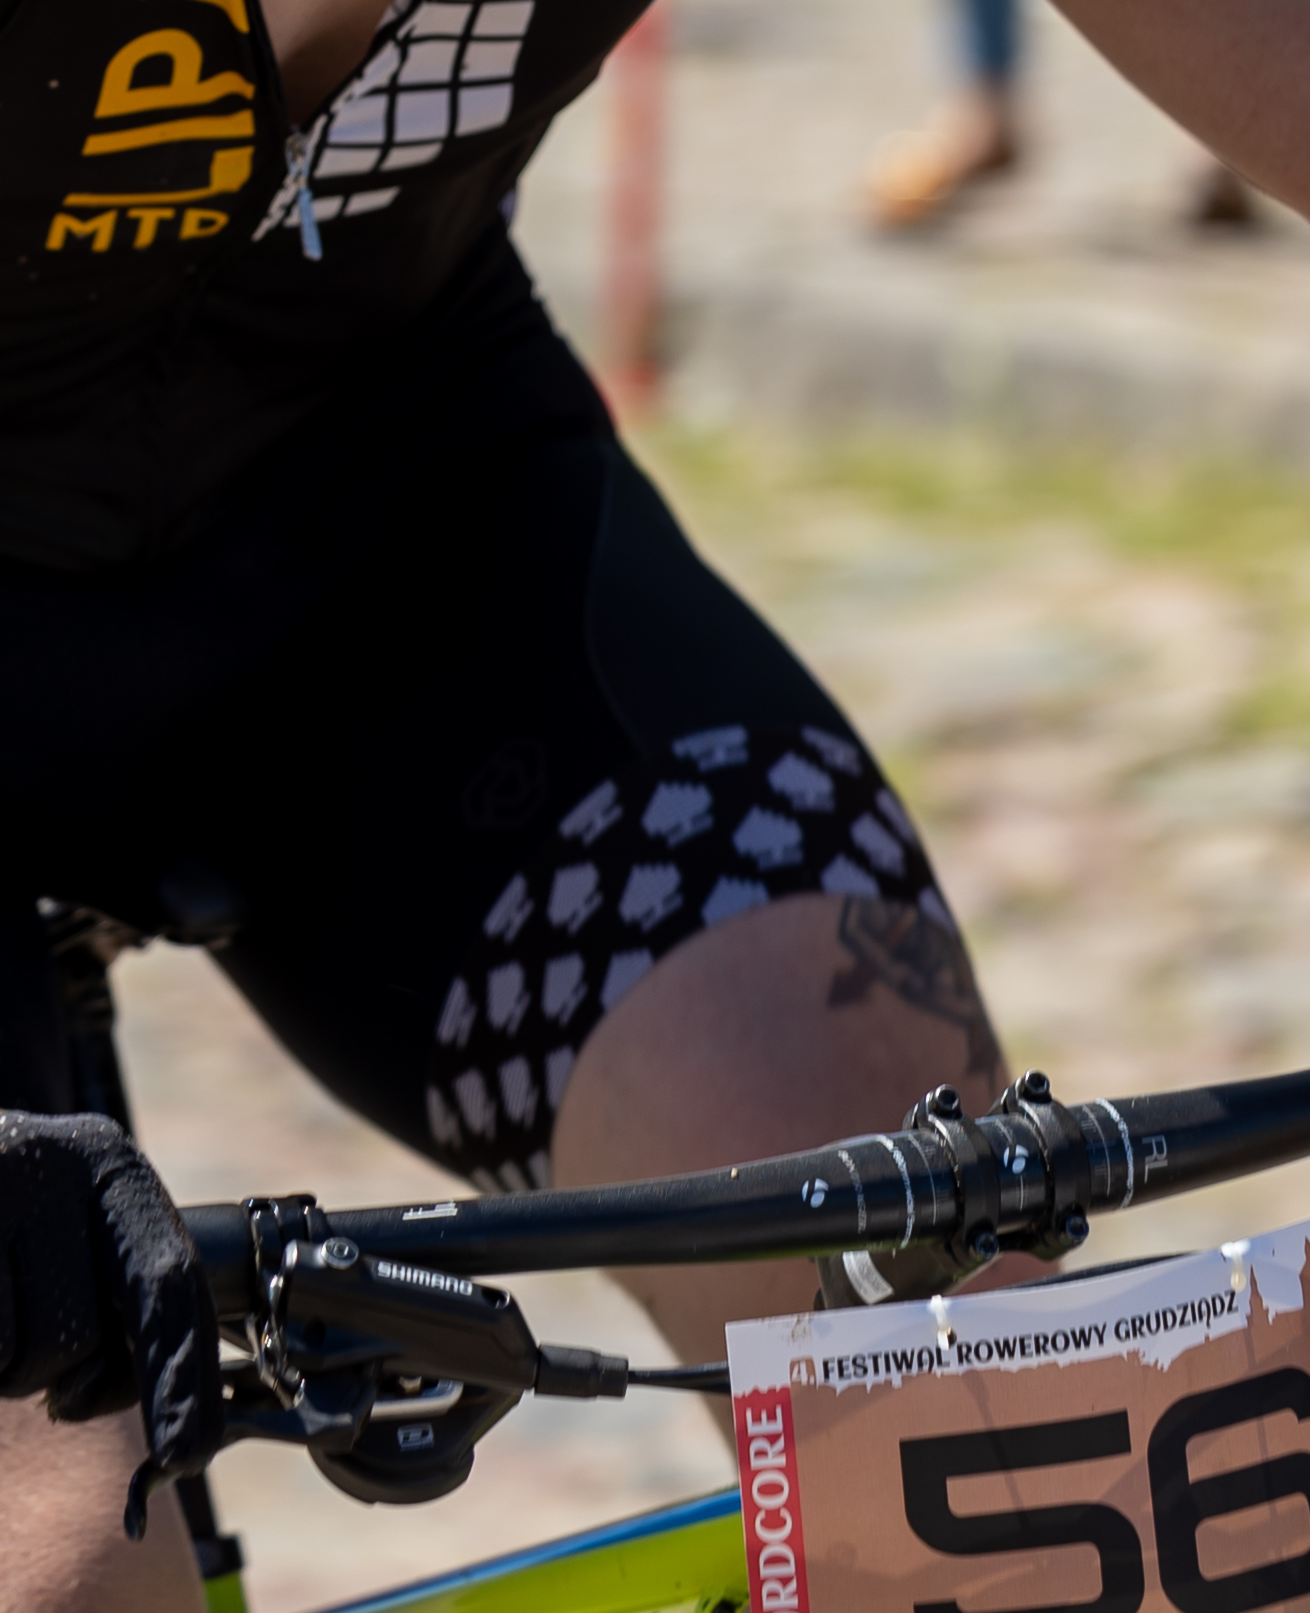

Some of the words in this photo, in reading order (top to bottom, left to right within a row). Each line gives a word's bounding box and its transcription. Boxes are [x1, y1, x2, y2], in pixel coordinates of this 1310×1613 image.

[376, 1260, 473, 1296] SHIMANO
[822, 1343, 951, 1383] FESTIWAL
[955, 1321, 1108, 1366] ROWEROWY
[1113, 1290, 1240, 1344] GRUDZIĄDZ
[744, 1403, 800, 1613] RDCORE
